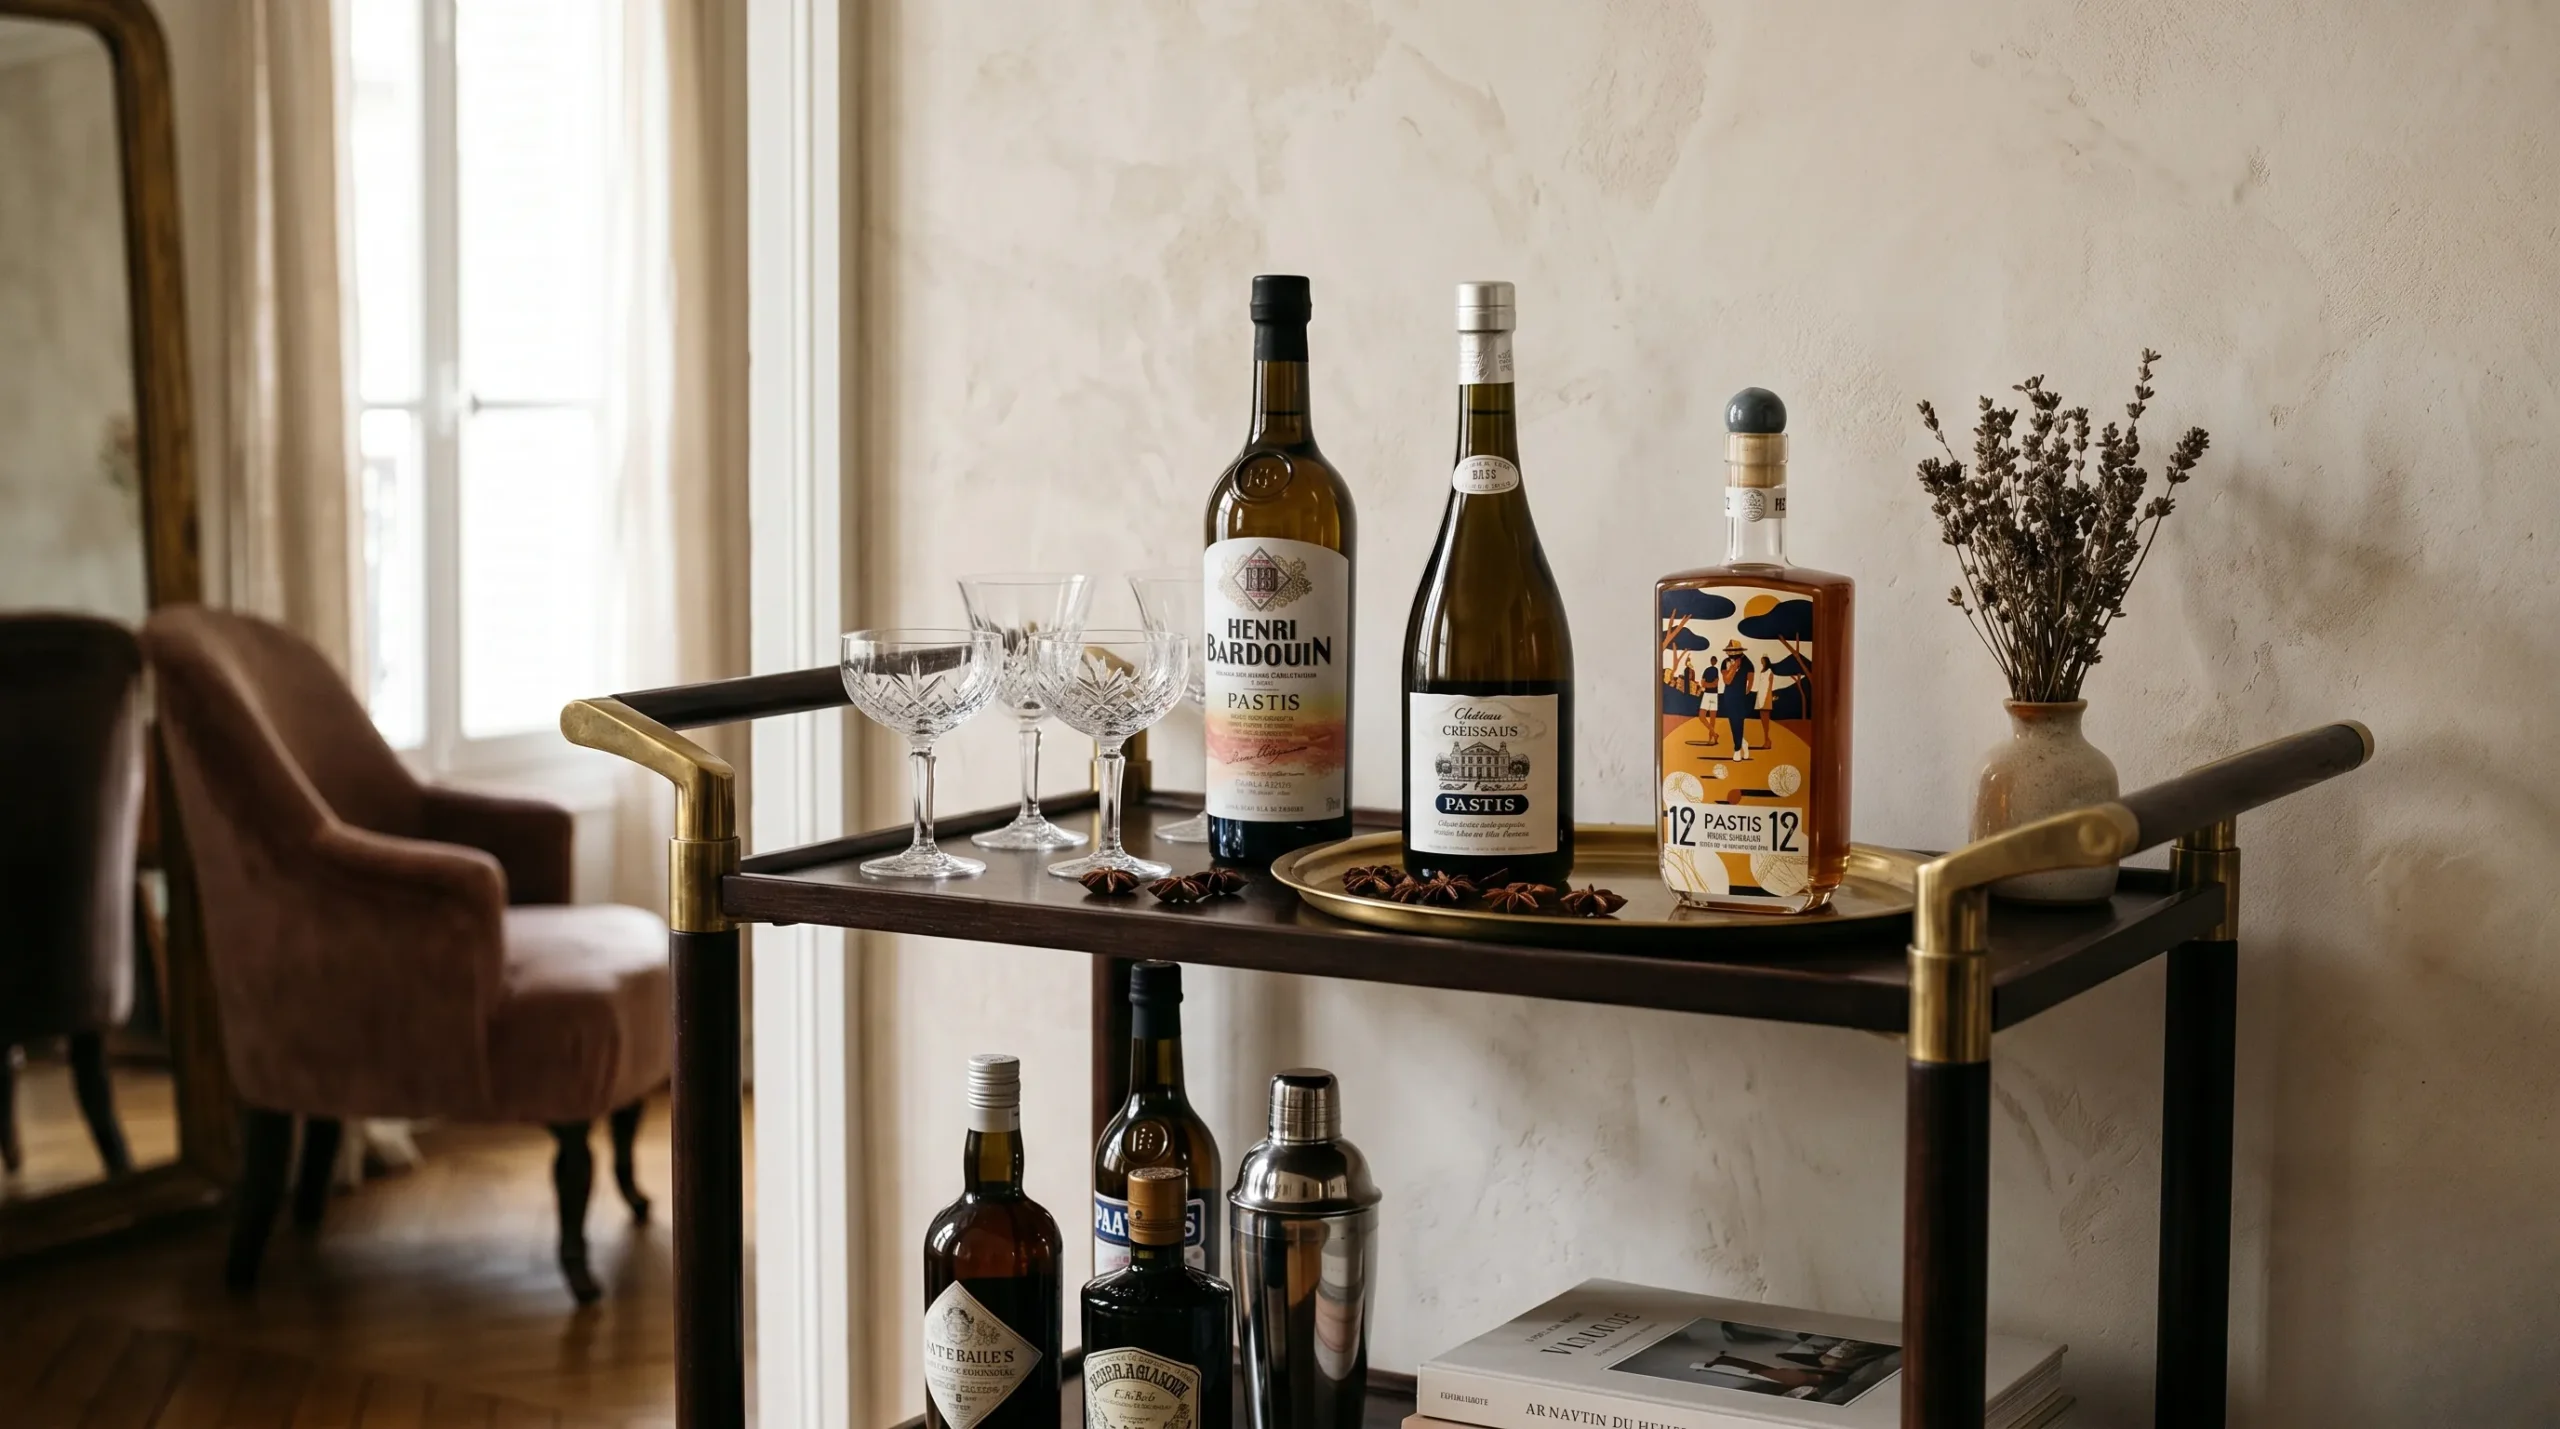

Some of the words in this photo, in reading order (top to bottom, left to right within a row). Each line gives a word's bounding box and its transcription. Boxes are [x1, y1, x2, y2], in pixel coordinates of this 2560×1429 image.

[1227, 618, 1296, 641] HENRI
[1207, 633, 1332, 667] BARDOUIN
[1227, 692, 1300, 711] PASTIS
[1444, 797, 1515, 812] PASTIS
[1669, 805, 1696, 847] 12
[1704, 813, 1762, 832] PASTIS
[1769, 811, 1799, 852] 12
